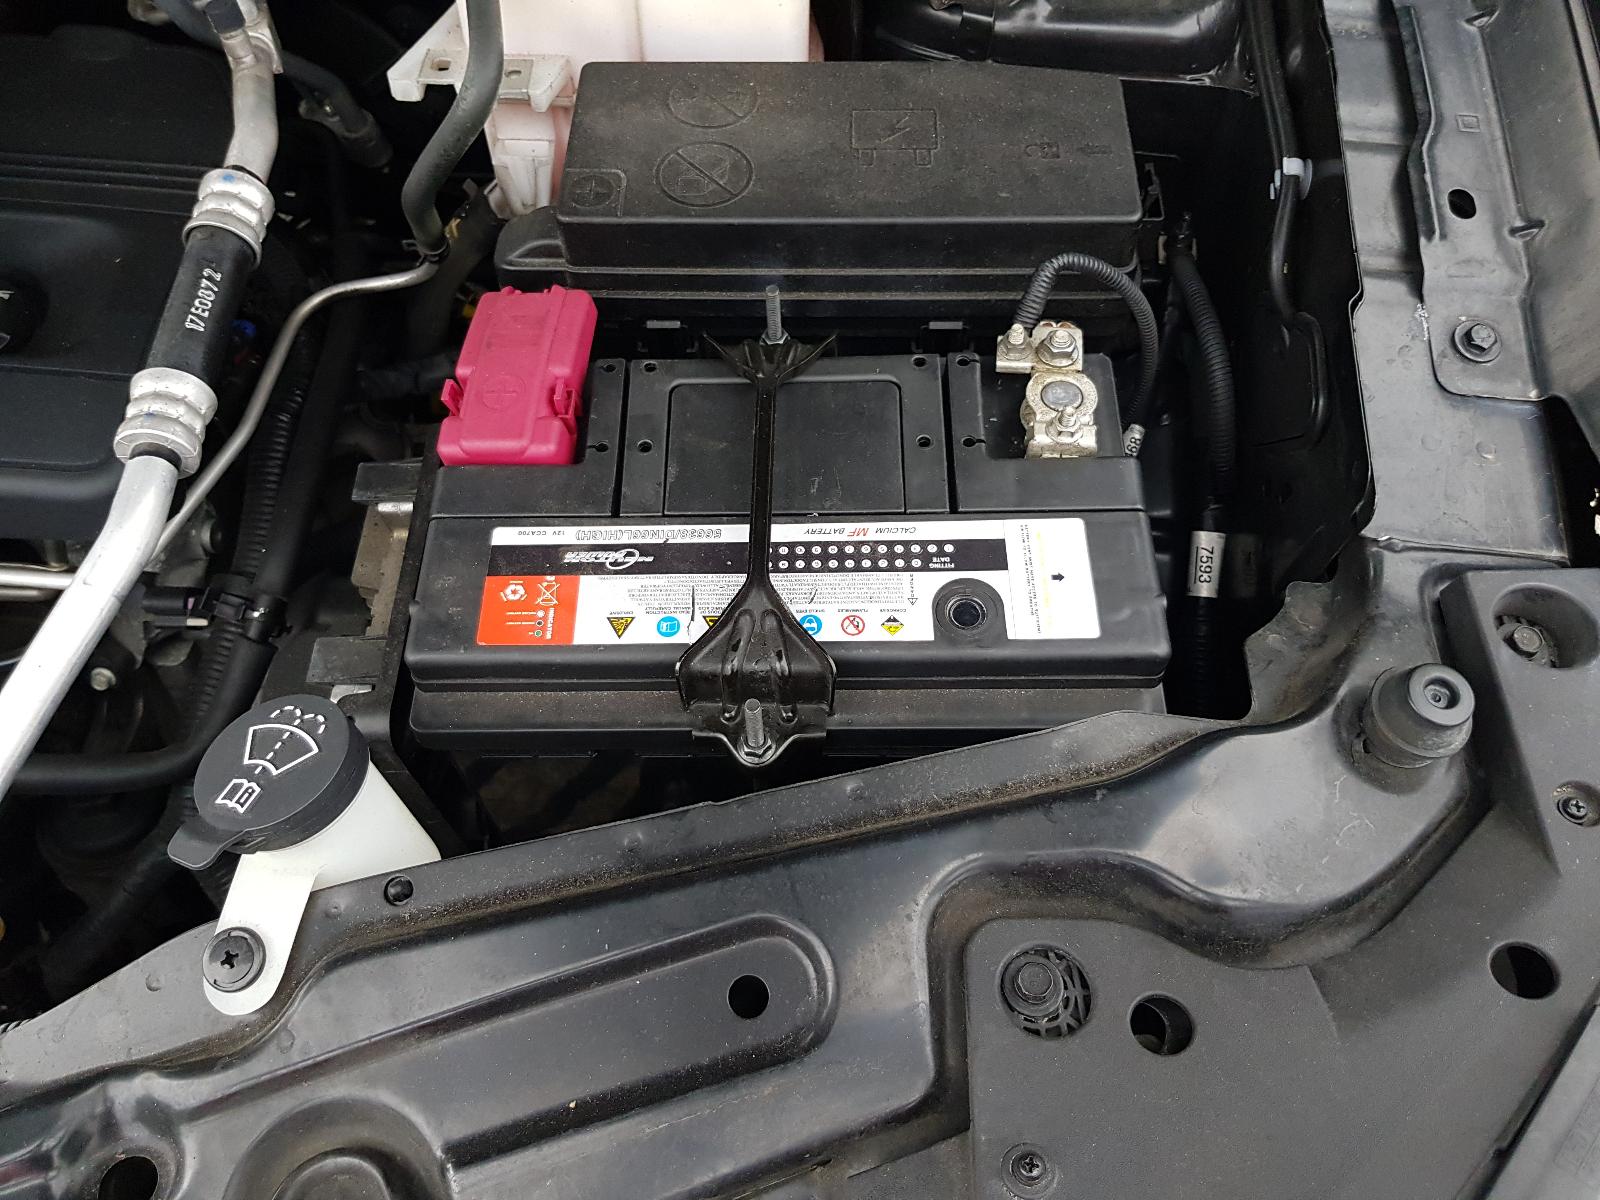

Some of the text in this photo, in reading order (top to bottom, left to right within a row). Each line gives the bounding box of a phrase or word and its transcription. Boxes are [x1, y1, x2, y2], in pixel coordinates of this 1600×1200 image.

[803, 526, 917, 537] CALCIUM MF BATTERY
[1198, 545, 1215, 585] 7593
